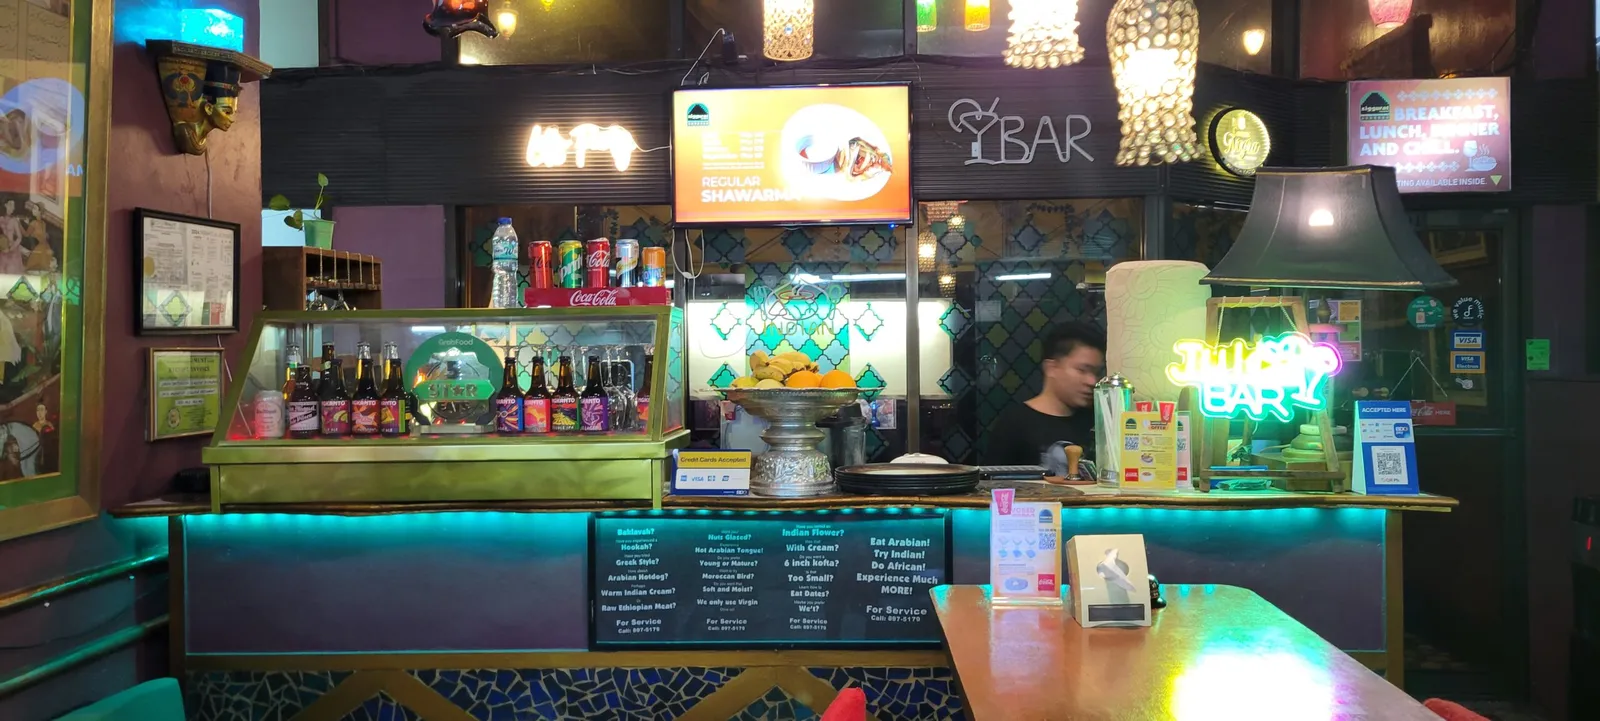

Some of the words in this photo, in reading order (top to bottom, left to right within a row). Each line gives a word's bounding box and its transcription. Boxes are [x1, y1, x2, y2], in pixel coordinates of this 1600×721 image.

[1394, 105, 1499, 121] BREAKFAST,
[1360, 125, 1426, 140] LUNCH,
[1001, 115, 1094, 162] BAR
[1360, 142, 1399, 156] AND
[702, 176, 761, 187] REGULAR
[1415, 178, 1458, 187] AVAILABLE
[1459, 177, 1487, 186] INSIDE.
[569, 290, 617, 306] Coca-Cola
[1454, 297, 1473, 307] value
[1474, 299, 1484, 319] music
[763, 320, 834, 336] INDIAN
[1204, 380, 1290, 417] BAR
[718, 456, 747, 464] Accepted
[812, 529, 844, 537] Flower?
[621, 543, 652, 551] Hookah?
[870, 537, 885, 546] Eat
[888, 538, 930, 547] Arabian!
[874, 549, 889, 559] Try
[891, 550, 925, 559] Indian!
[639, 558, 660, 567] Style?
[784, 559, 790, 567] 6
[792, 559, 810, 567] inch
[812, 558, 840, 567] kofta?
[871, 561, 885, 569] Do
[887, 561, 926, 571] African!
[639, 573, 669, 581] Hotdog?
[806, 574, 834, 582] Small?
[856, 573, 910, 582] Experience
[912, 575, 938, 584] Much
[649, 587, 676, 595] Cream?
[881, 585, 913, 595] MORE!
[619, 603, 653, 612] Ethiopian
[654, 602, 676, 610] Meat?
[866, 605, 883, 613] For
[886, 606, 927, 615] Service
[631, 618, 662, 626] Service
